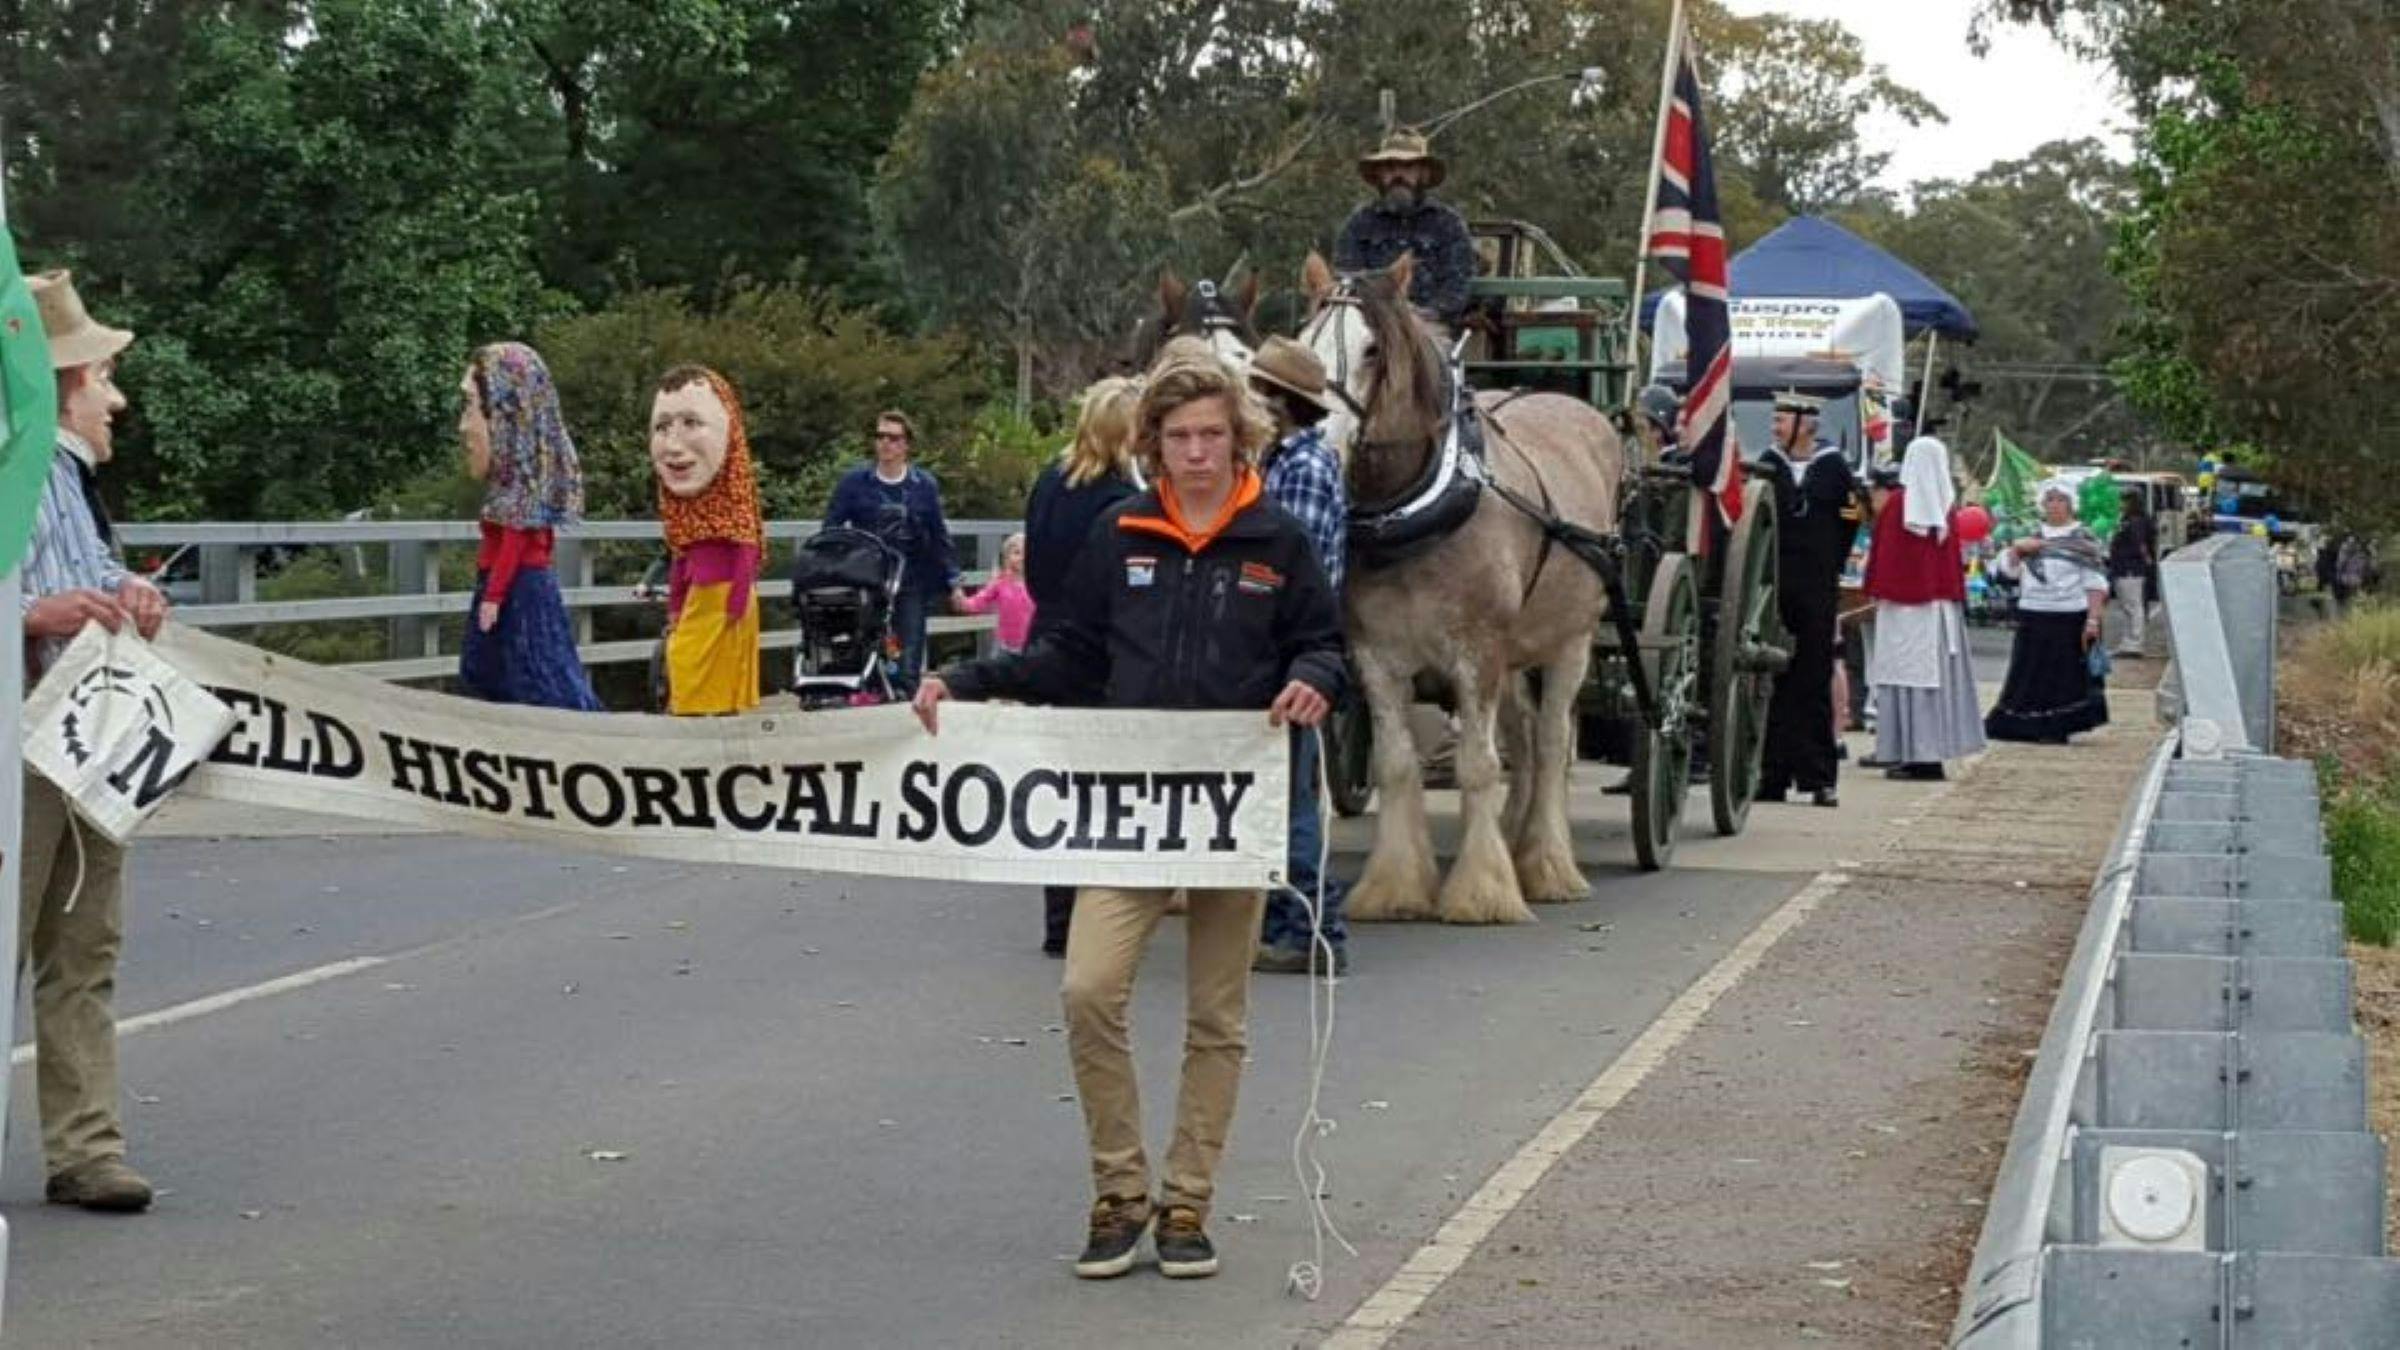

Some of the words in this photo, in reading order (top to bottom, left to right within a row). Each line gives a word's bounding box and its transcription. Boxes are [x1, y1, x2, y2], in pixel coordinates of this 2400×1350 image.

[200, 684, 365, 778] ELD
[380, 731, 881, 837] HISTORICAL
[897, 760, 1255, 852] SOCIETY
